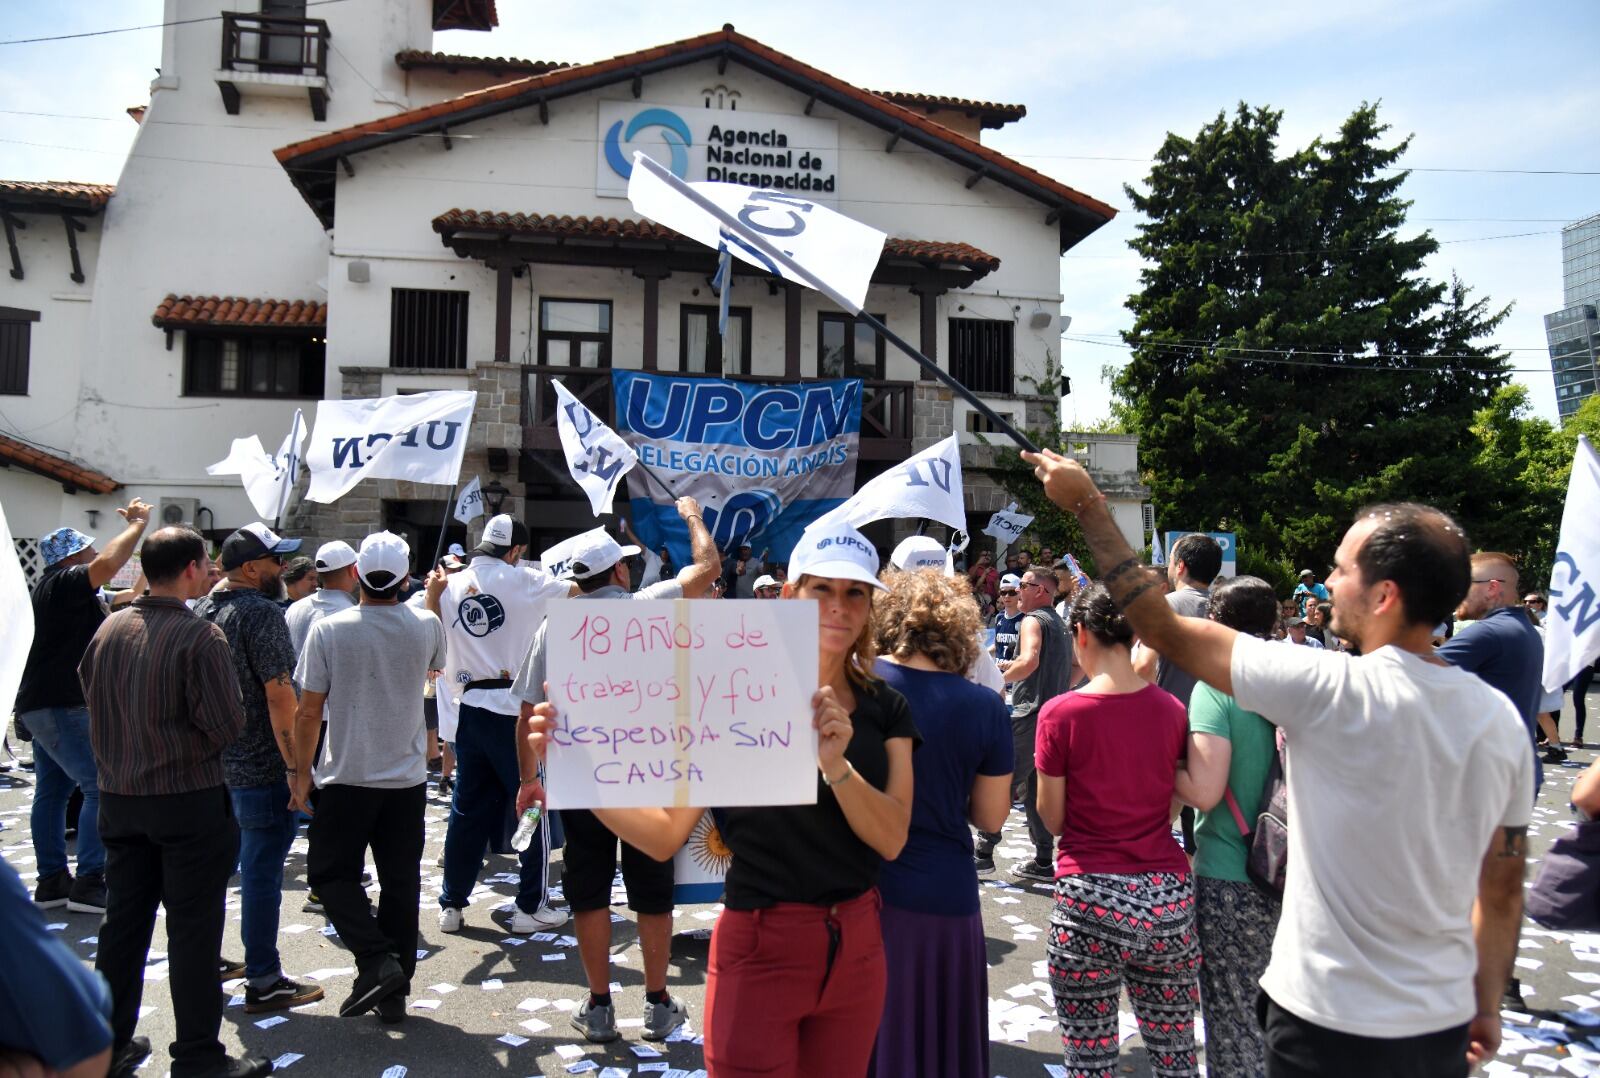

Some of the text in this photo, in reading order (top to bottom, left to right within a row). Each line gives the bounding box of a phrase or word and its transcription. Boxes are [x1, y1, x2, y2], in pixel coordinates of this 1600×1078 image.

[708, 125, 787, 148] Agencia
[707, 146, 822, 170] Nacional de
[707, 166, 835, 192] Discapacidad
[626, 377, 860, 451] UPCN
[836, 535, 872, 557] UPCN
[570, 615, 611, 661] 18
[725, 614, 769, 649] de
[562, 672, 681, 713] trabajos
[721, 668, 779, 716] fui
[594, 760, 704, 785] CAUSA
